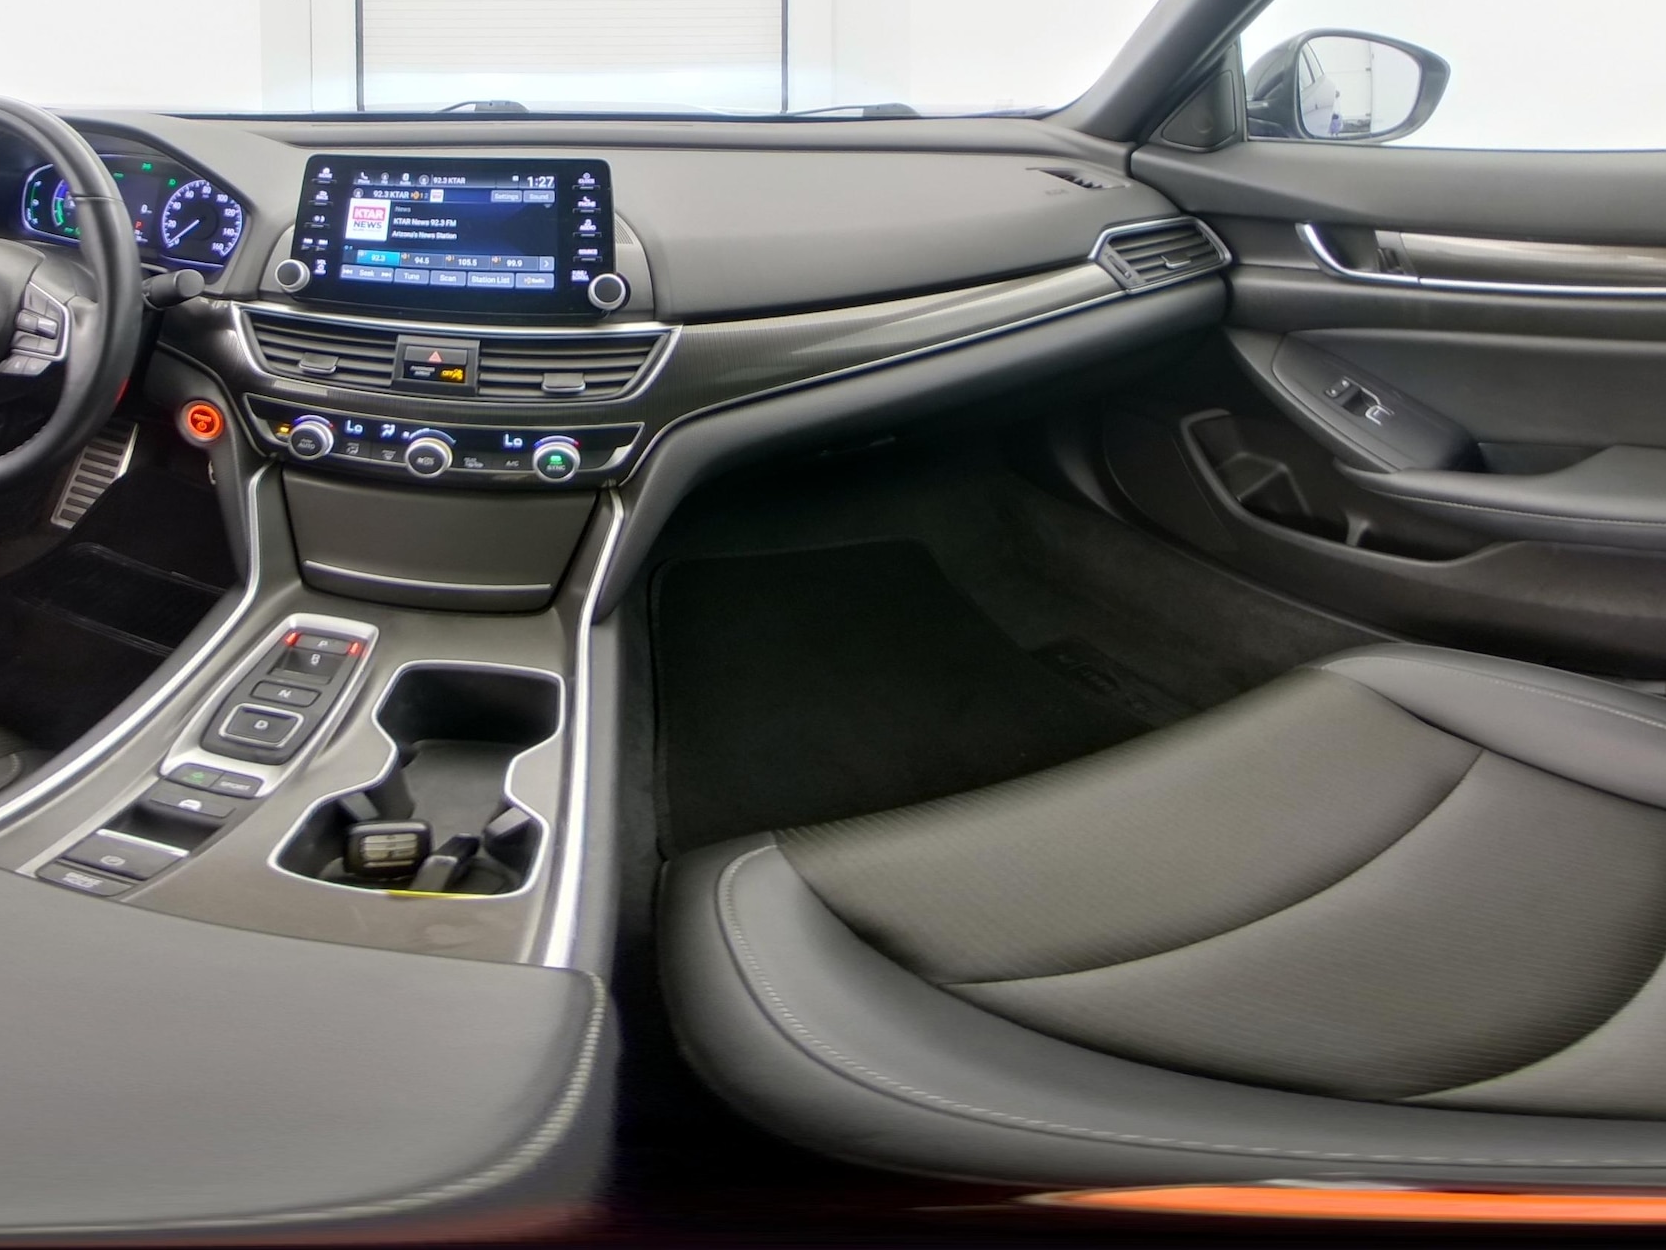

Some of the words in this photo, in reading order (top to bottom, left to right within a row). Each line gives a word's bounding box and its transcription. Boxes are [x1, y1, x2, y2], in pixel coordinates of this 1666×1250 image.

[433, 177, 447, 185] 92.3
[448, 177, 466, 185] KTAR
[527, 176, 555, 188] 1:27
[185, 190, 194, 198] 60
[202, 186, 212, 194] 80
[216, 194, 228, 203] 100
[373, 190, 389, 198] 92.3
[390, 191, 410, 199] KTAR
[494, 193, 519, 201] Settings
[141, 204, 148, 214] 0
[224, 208, 236, 217] 120
[354, 208, 384, 220] KTAR
[167, 220, 177, 228] 20
[353, 220, 382, 228] NEWS
[393, 217, 411, 225] KTAR
[412, 218, 429, 226] News
[430, 219, 445, 227] 92.3
[223, 228, 235, 236] 140
[392, 230, 418, 238] Arizona's
[419, 231, 435, 239] News
[212, 242, 224, 251] 160
[414, 257, 430, 265] 94.5
[458, 258, 478, 266] 105.5
[506, 259, 523, 267] 99.9
[359, 269, 374, 277] Seek
[404, 272, 420, 280] Tune
[439, 274, 457, 282] Scan
[471, 275, 496, 284] Station
[497, 276, 510, 284] List
[345, 420, 364, 434] Lo
[504, 433, 523, 448] Lo
[317, 640, 329, 648] P
[278, 689, 292, 699] N
[254, 720, 269, 730] D
